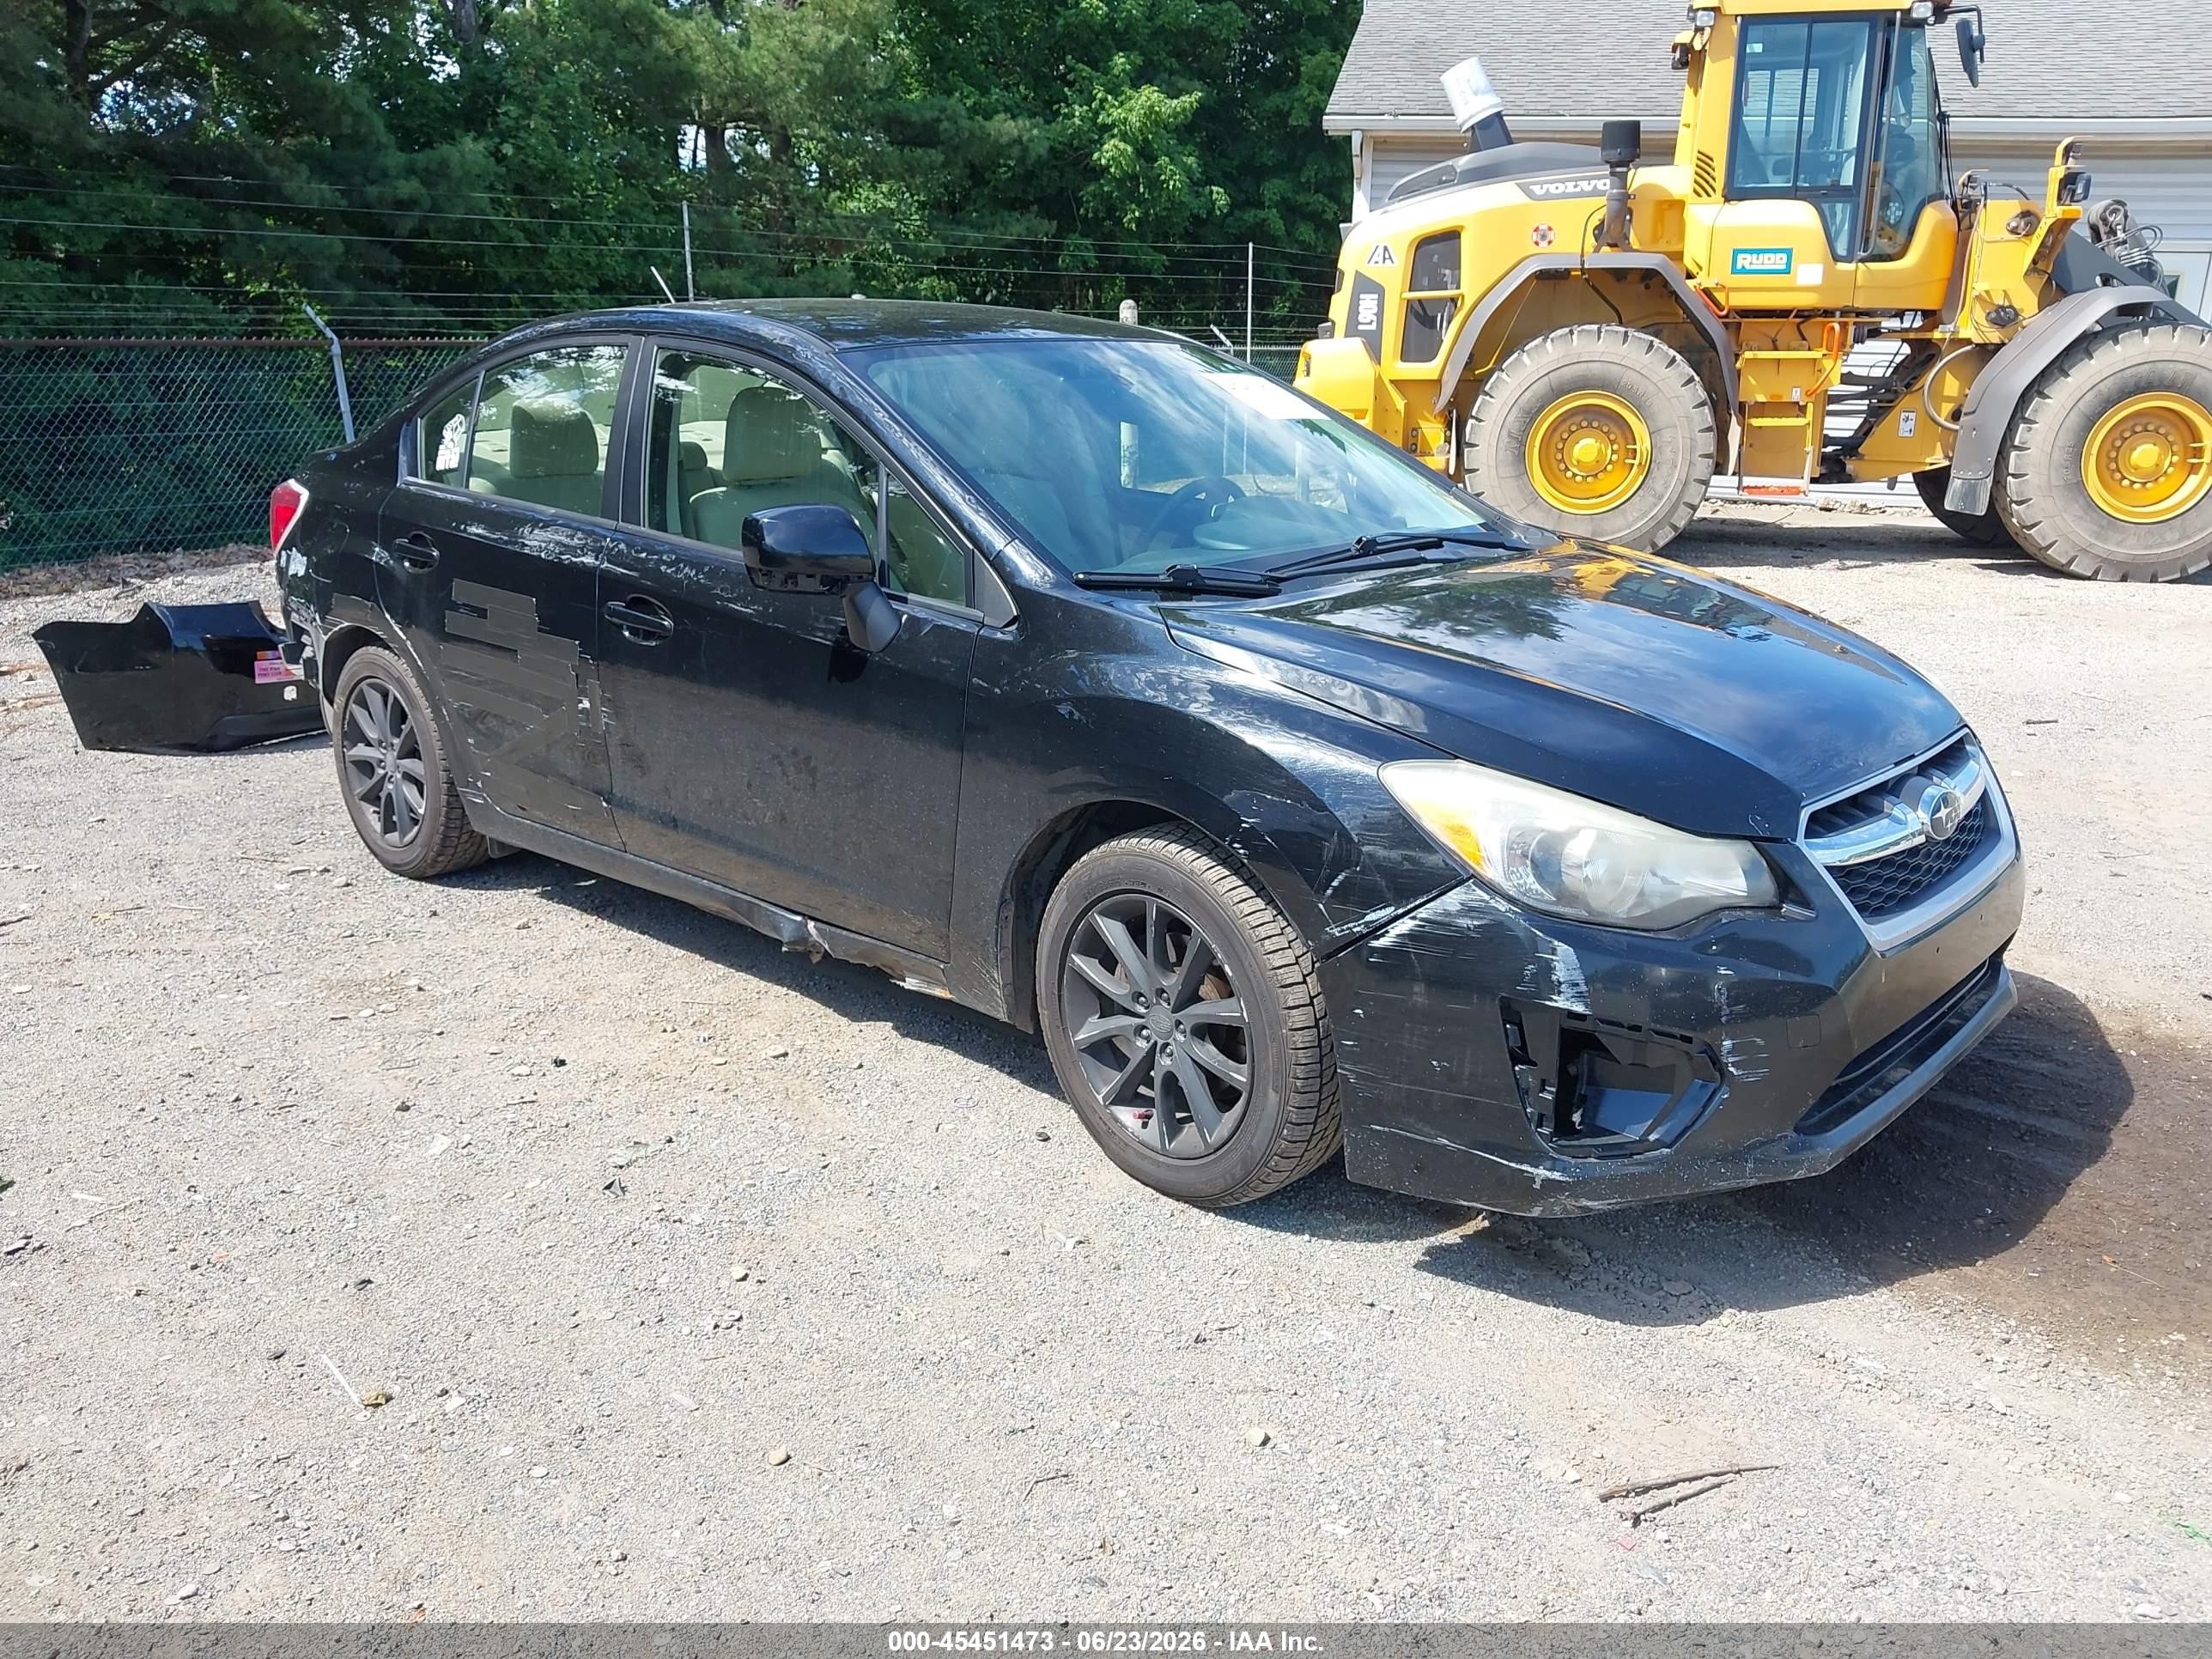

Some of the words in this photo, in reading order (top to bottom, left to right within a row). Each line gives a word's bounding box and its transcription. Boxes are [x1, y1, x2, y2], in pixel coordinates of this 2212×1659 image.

[1528, 178, 1610, 196] VOLVO
[1735, 252, 1788, 270] RUDD
[1357, 293, 1379, 331] L90H
